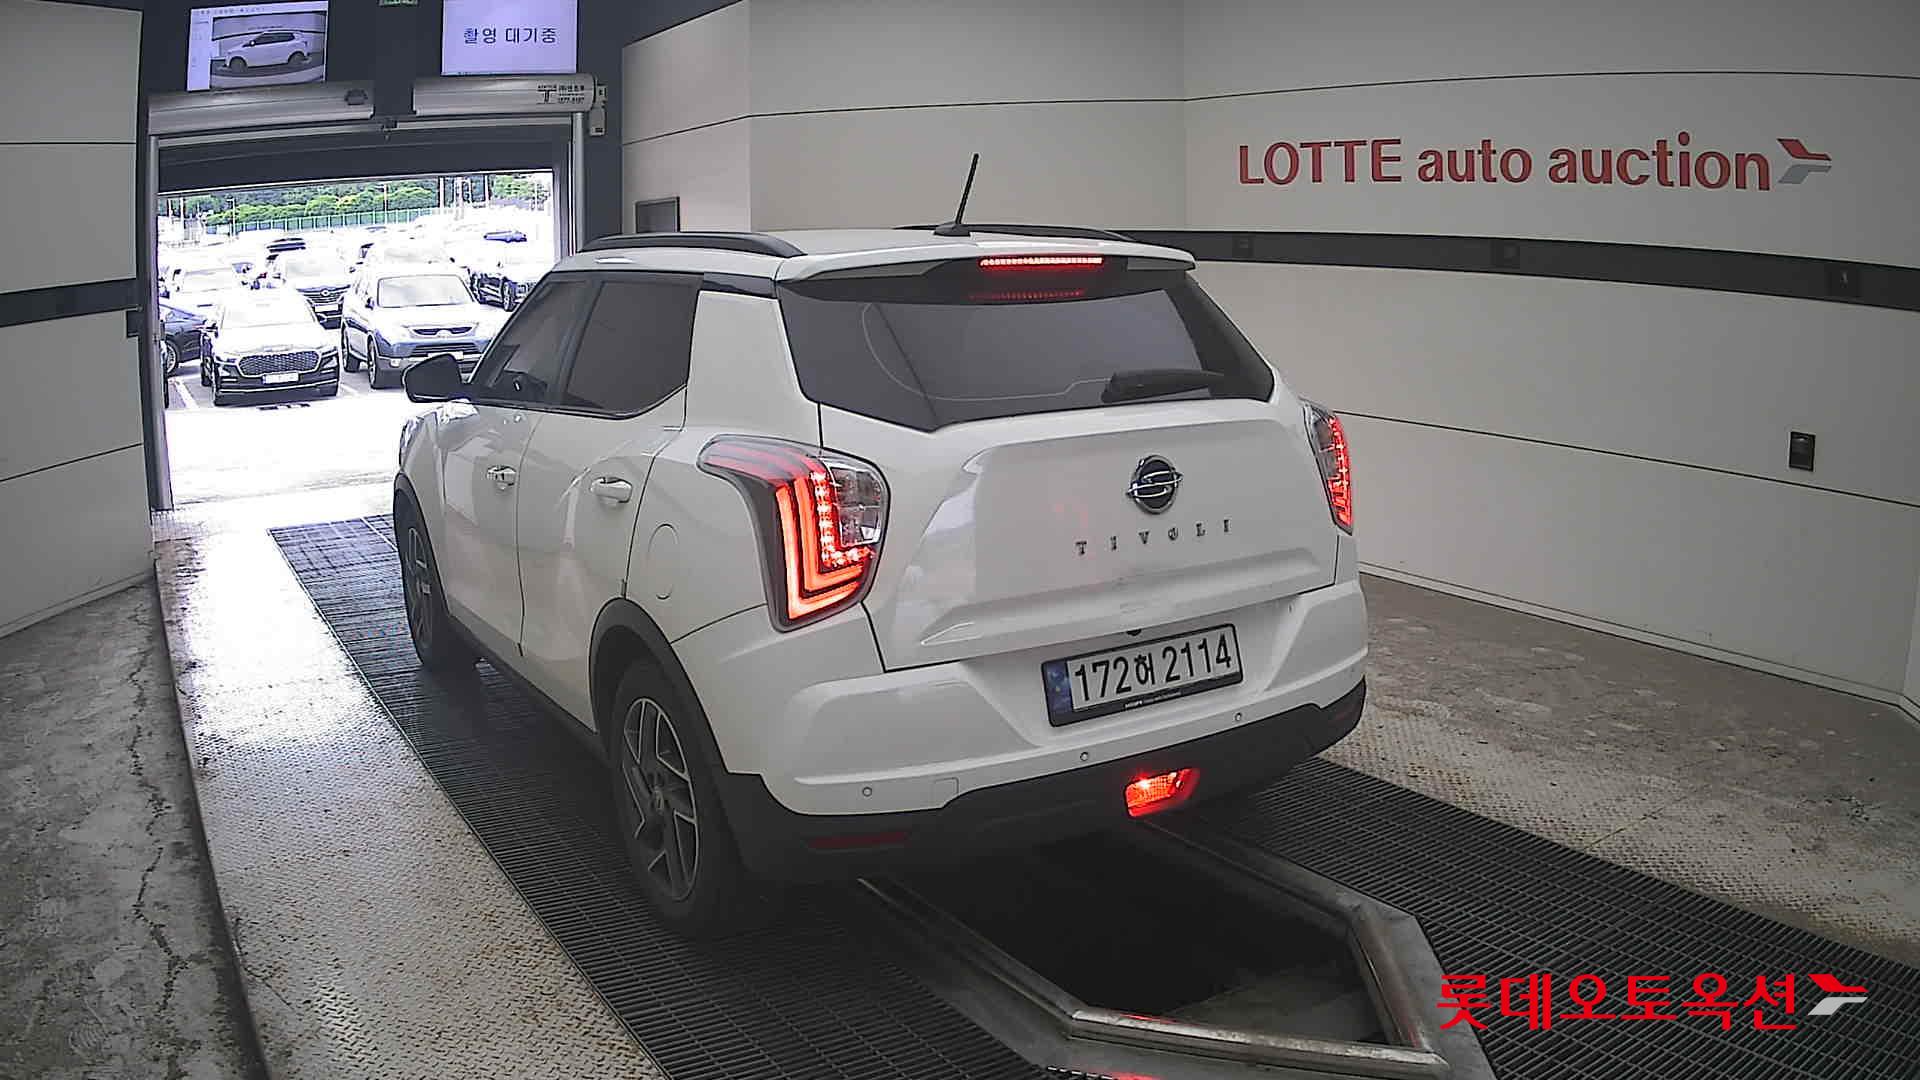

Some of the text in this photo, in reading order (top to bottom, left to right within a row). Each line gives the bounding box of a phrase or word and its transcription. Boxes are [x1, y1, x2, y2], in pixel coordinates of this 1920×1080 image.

[505, 27, 556, 44] 대기중
[1239, 131, 1770, 191] LOTTE auto auction
[1075, 518, 1231, 555] TIVOLI
[1074, 633, 1232, 702] 172허 2114
